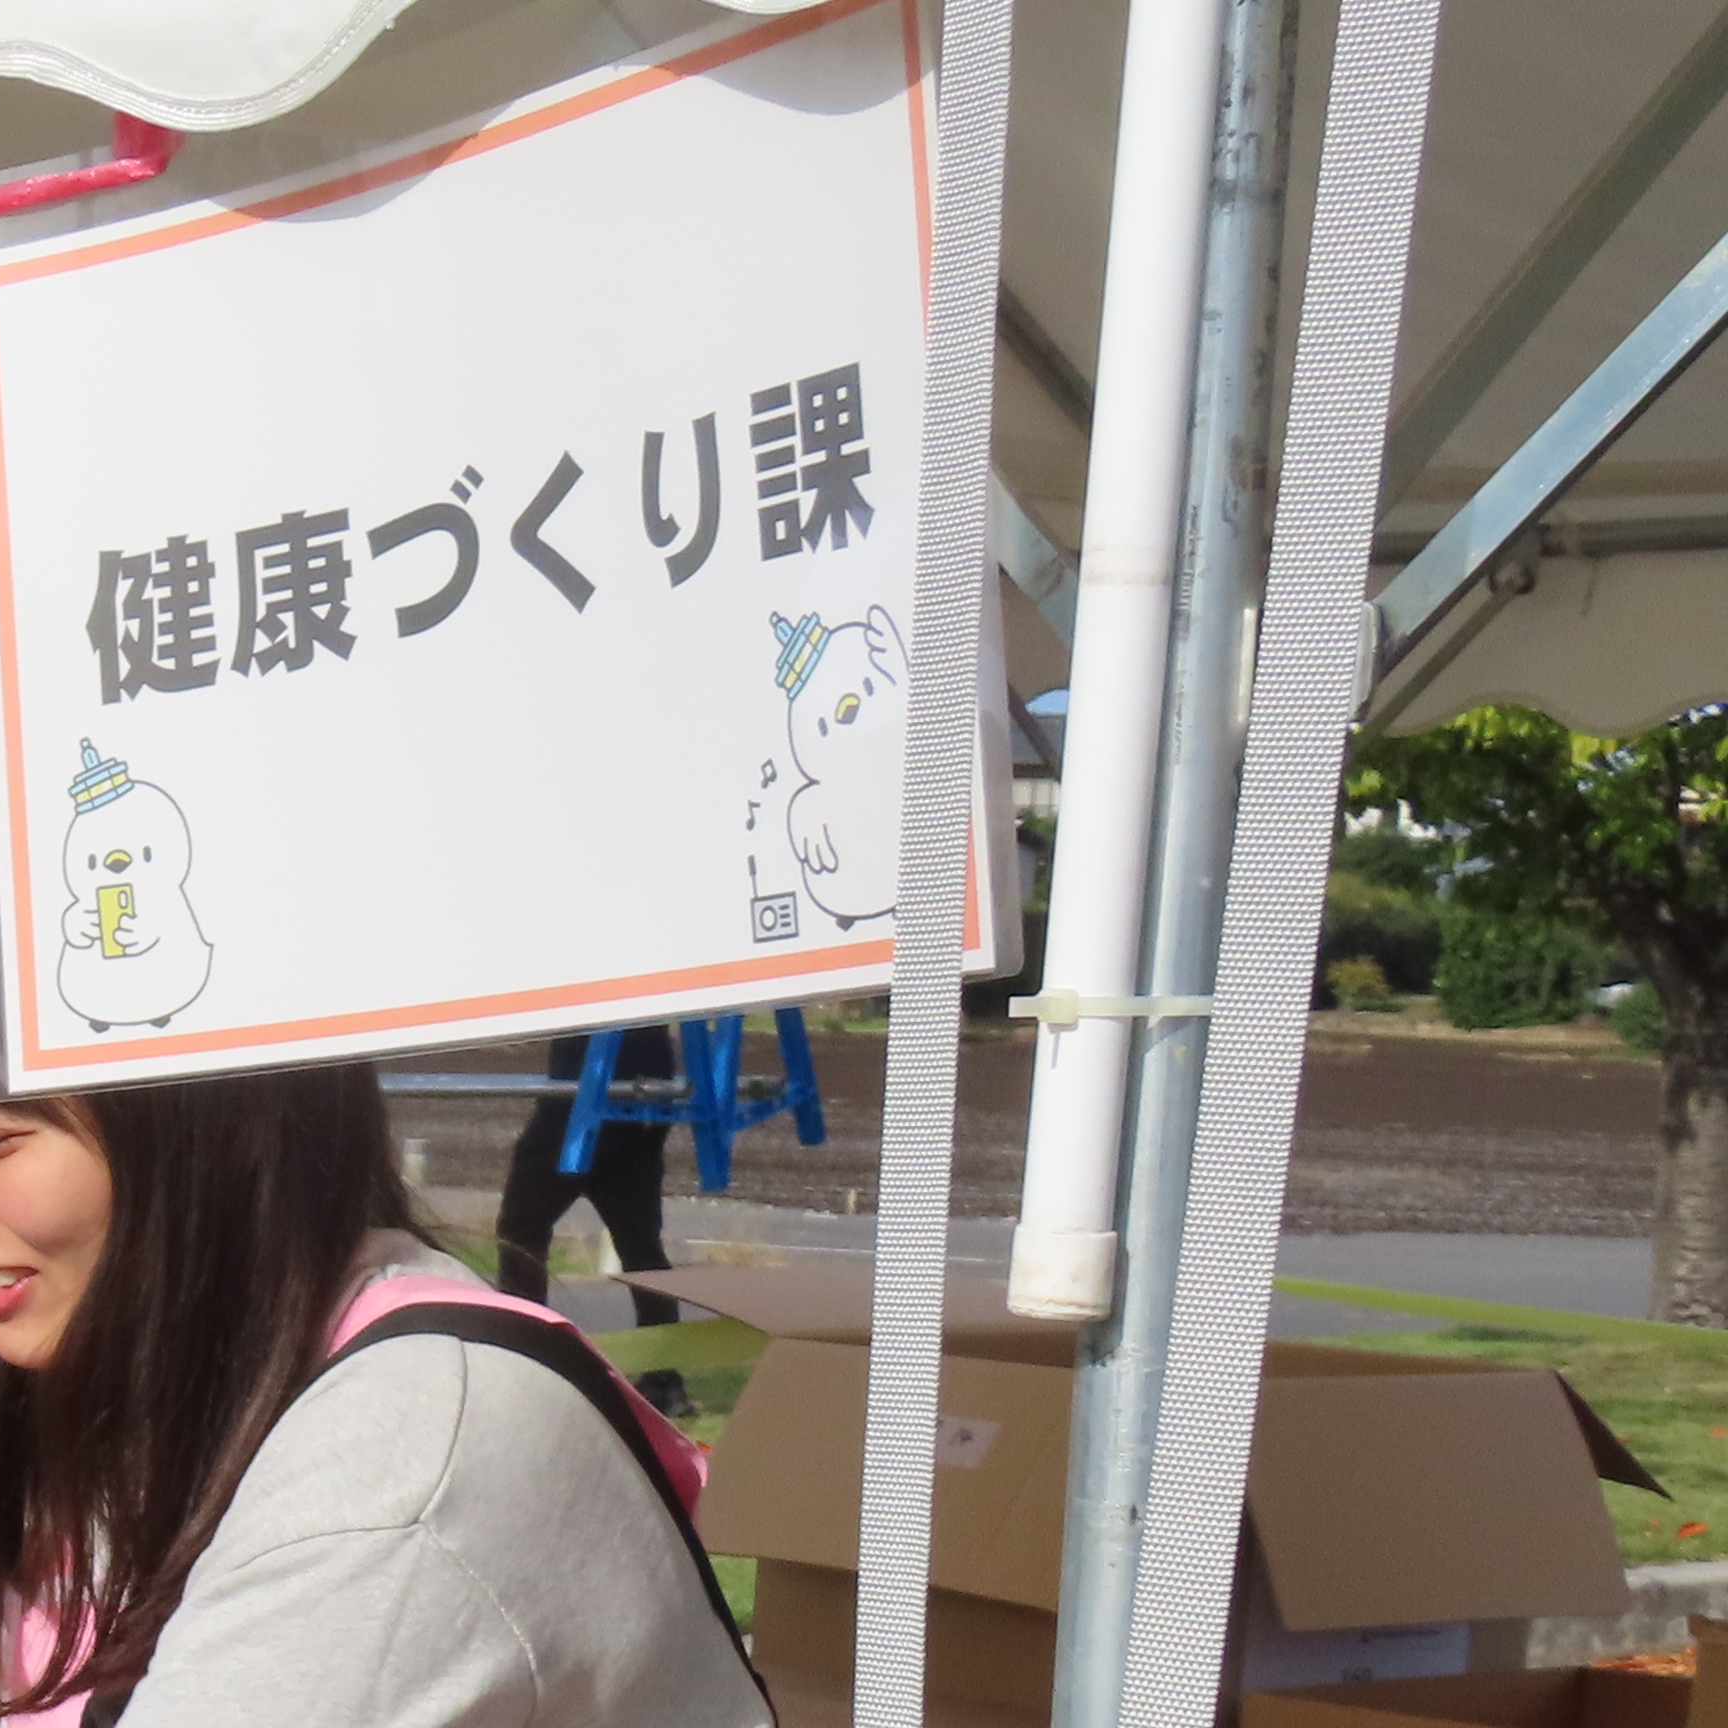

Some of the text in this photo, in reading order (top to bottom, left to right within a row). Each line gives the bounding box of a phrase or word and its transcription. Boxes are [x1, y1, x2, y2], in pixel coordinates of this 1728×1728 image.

[86, 362, 876, 704] 健康づくり課
